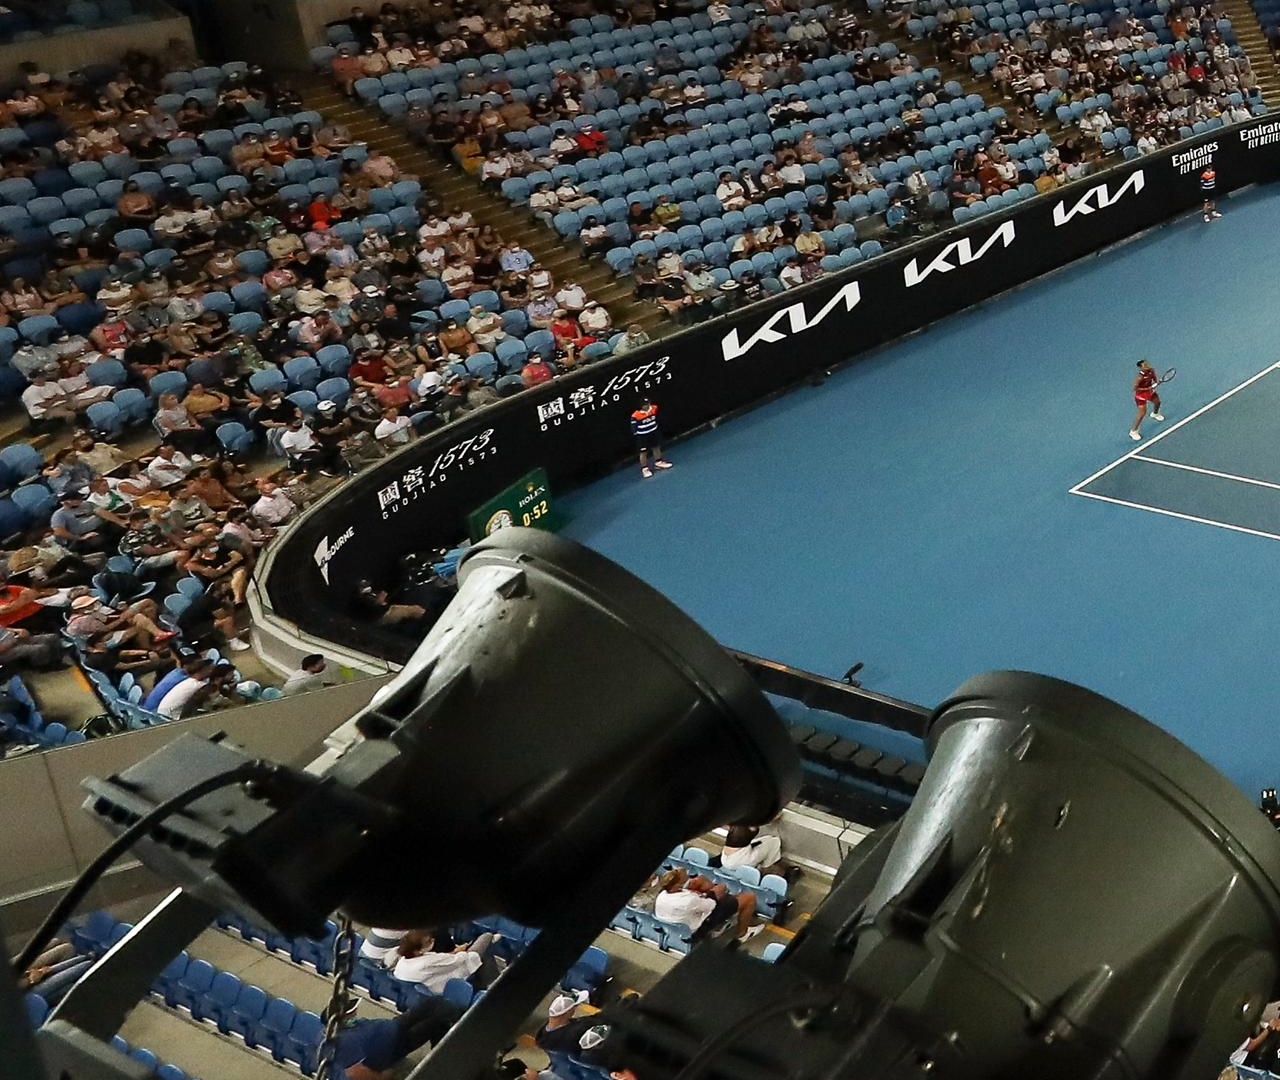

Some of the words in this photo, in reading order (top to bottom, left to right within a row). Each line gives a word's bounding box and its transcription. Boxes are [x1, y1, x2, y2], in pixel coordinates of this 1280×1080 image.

[1171, 141, 1219, 167] Emirates
[1052, 168, 1146, 227] KIA
[902, 219, 1016, 288] KIA
[721, 280, 861, 362] KIA
[522, 500, 549, 527] 0:52
